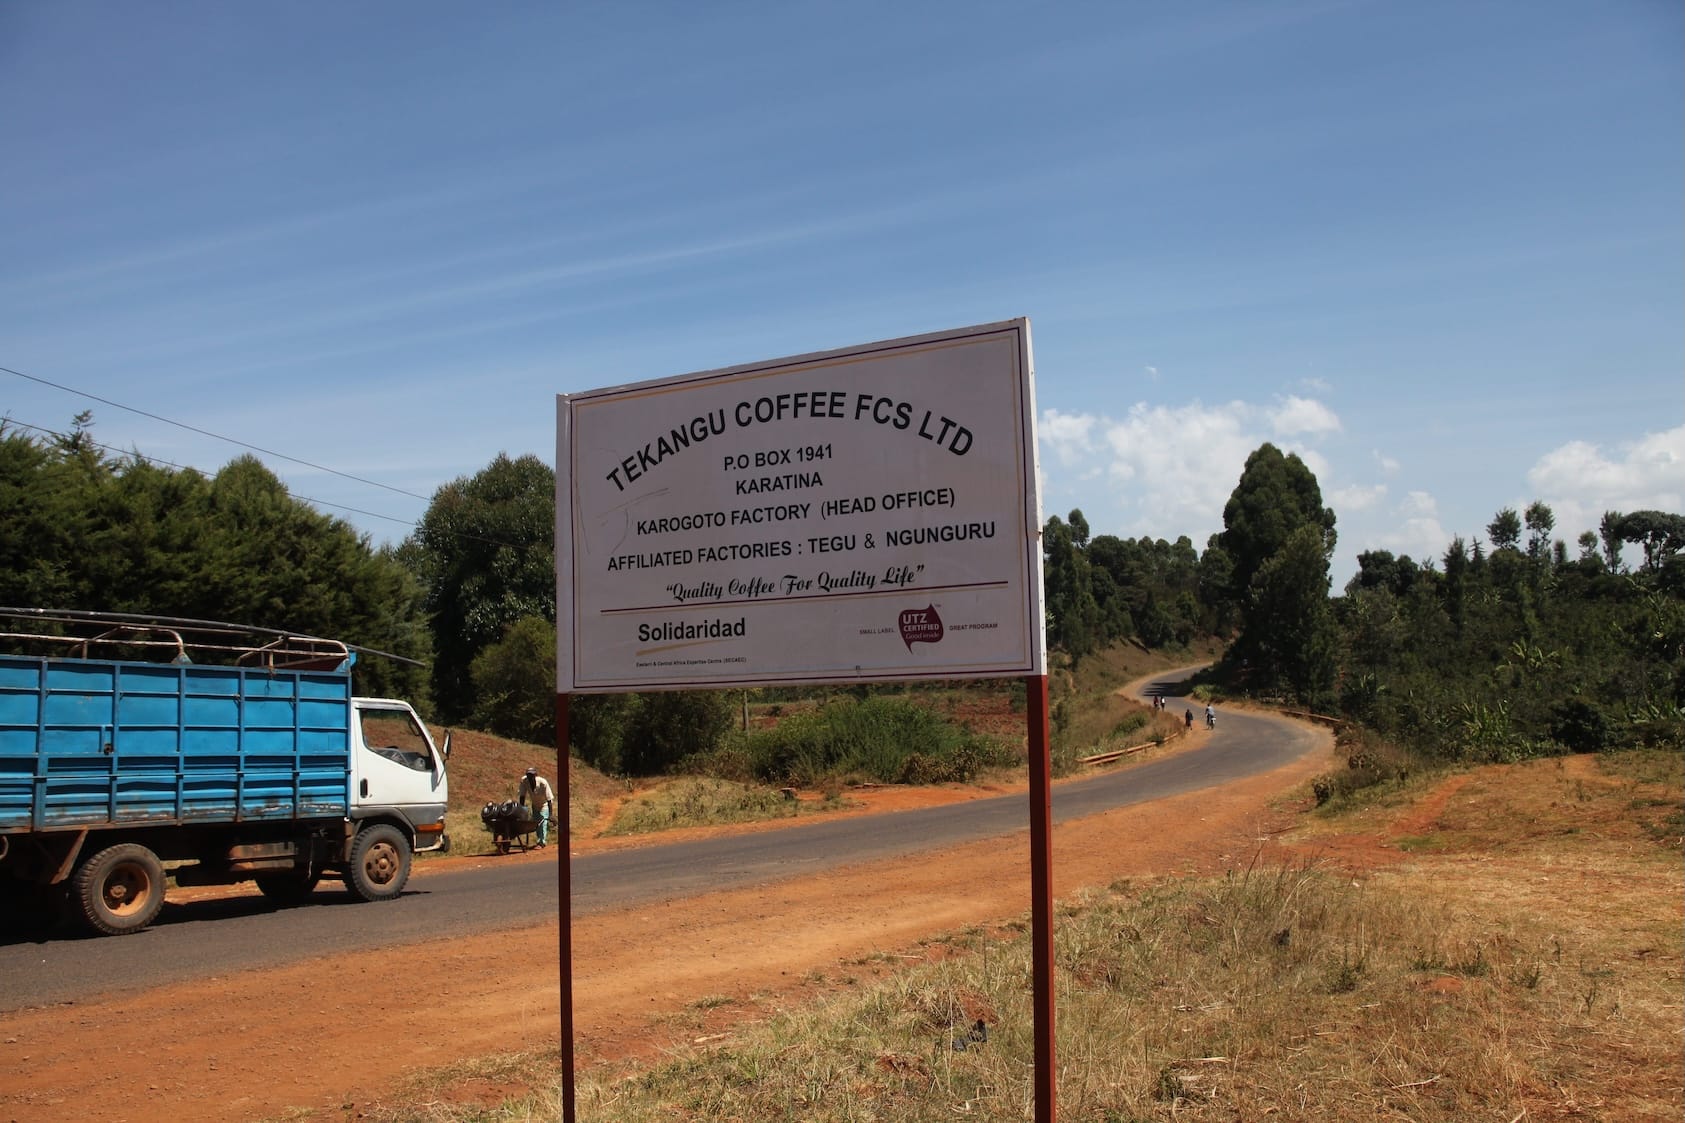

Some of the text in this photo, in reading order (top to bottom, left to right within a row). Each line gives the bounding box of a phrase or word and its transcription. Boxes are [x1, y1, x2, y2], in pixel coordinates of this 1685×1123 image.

[606, 391, 974, 492] TEKANGU COFFEE FCS LTD
[724, 443, 832, 471] P.O BOX 1941
[736, 471, 823, 495] KARATINA
[637, 487, 955, 535] KAROGOTO FACTORY (HEAD OFFICE)
[607, 550, 693, 571] AFFILIATED
[698, 540, 792, 563] FACTORIES
[808, 535, 856, 553] TEGU
[864, 533, 875, 549] &
[886, 521, 995, 547] NGUNGURU
[666, 564, 925, 601] “Quality Coffee For Quality Life”
[638, 617, 745, 642] Solidaridad
[878, 626, 895, 634] LABEL
[902, 613, 928, 625] UTZ
[903, 623, 940, 632] CERTIFIED
[969, 622, 999, 630] PROGRAM
